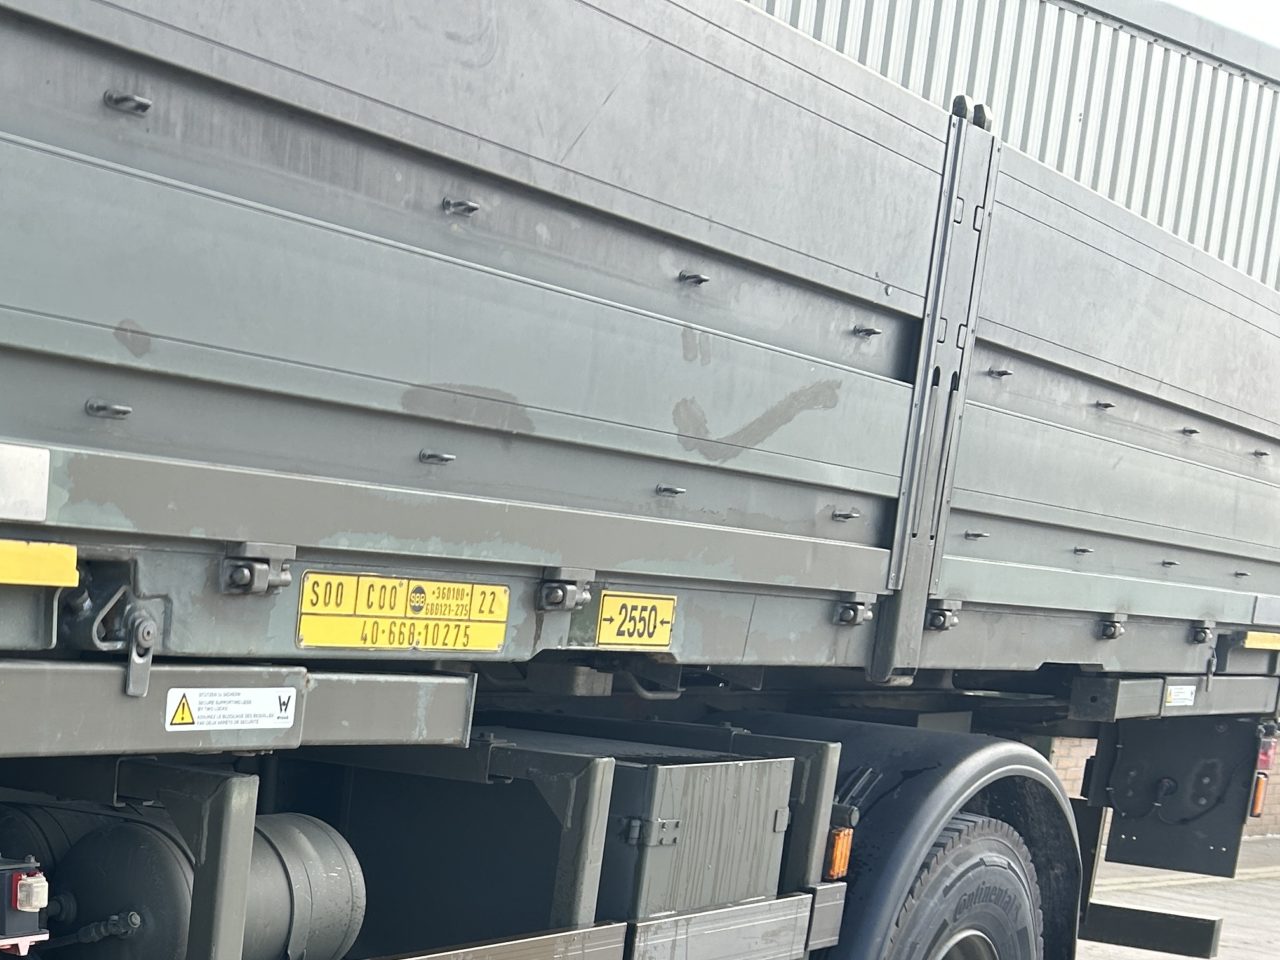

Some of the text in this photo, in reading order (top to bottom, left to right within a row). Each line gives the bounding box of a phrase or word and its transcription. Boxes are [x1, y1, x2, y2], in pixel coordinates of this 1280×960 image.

[478, 590, 496, 615] 22
[615, 602, 658, 639] 2550
[952, 880, 1018, 923] Continental
